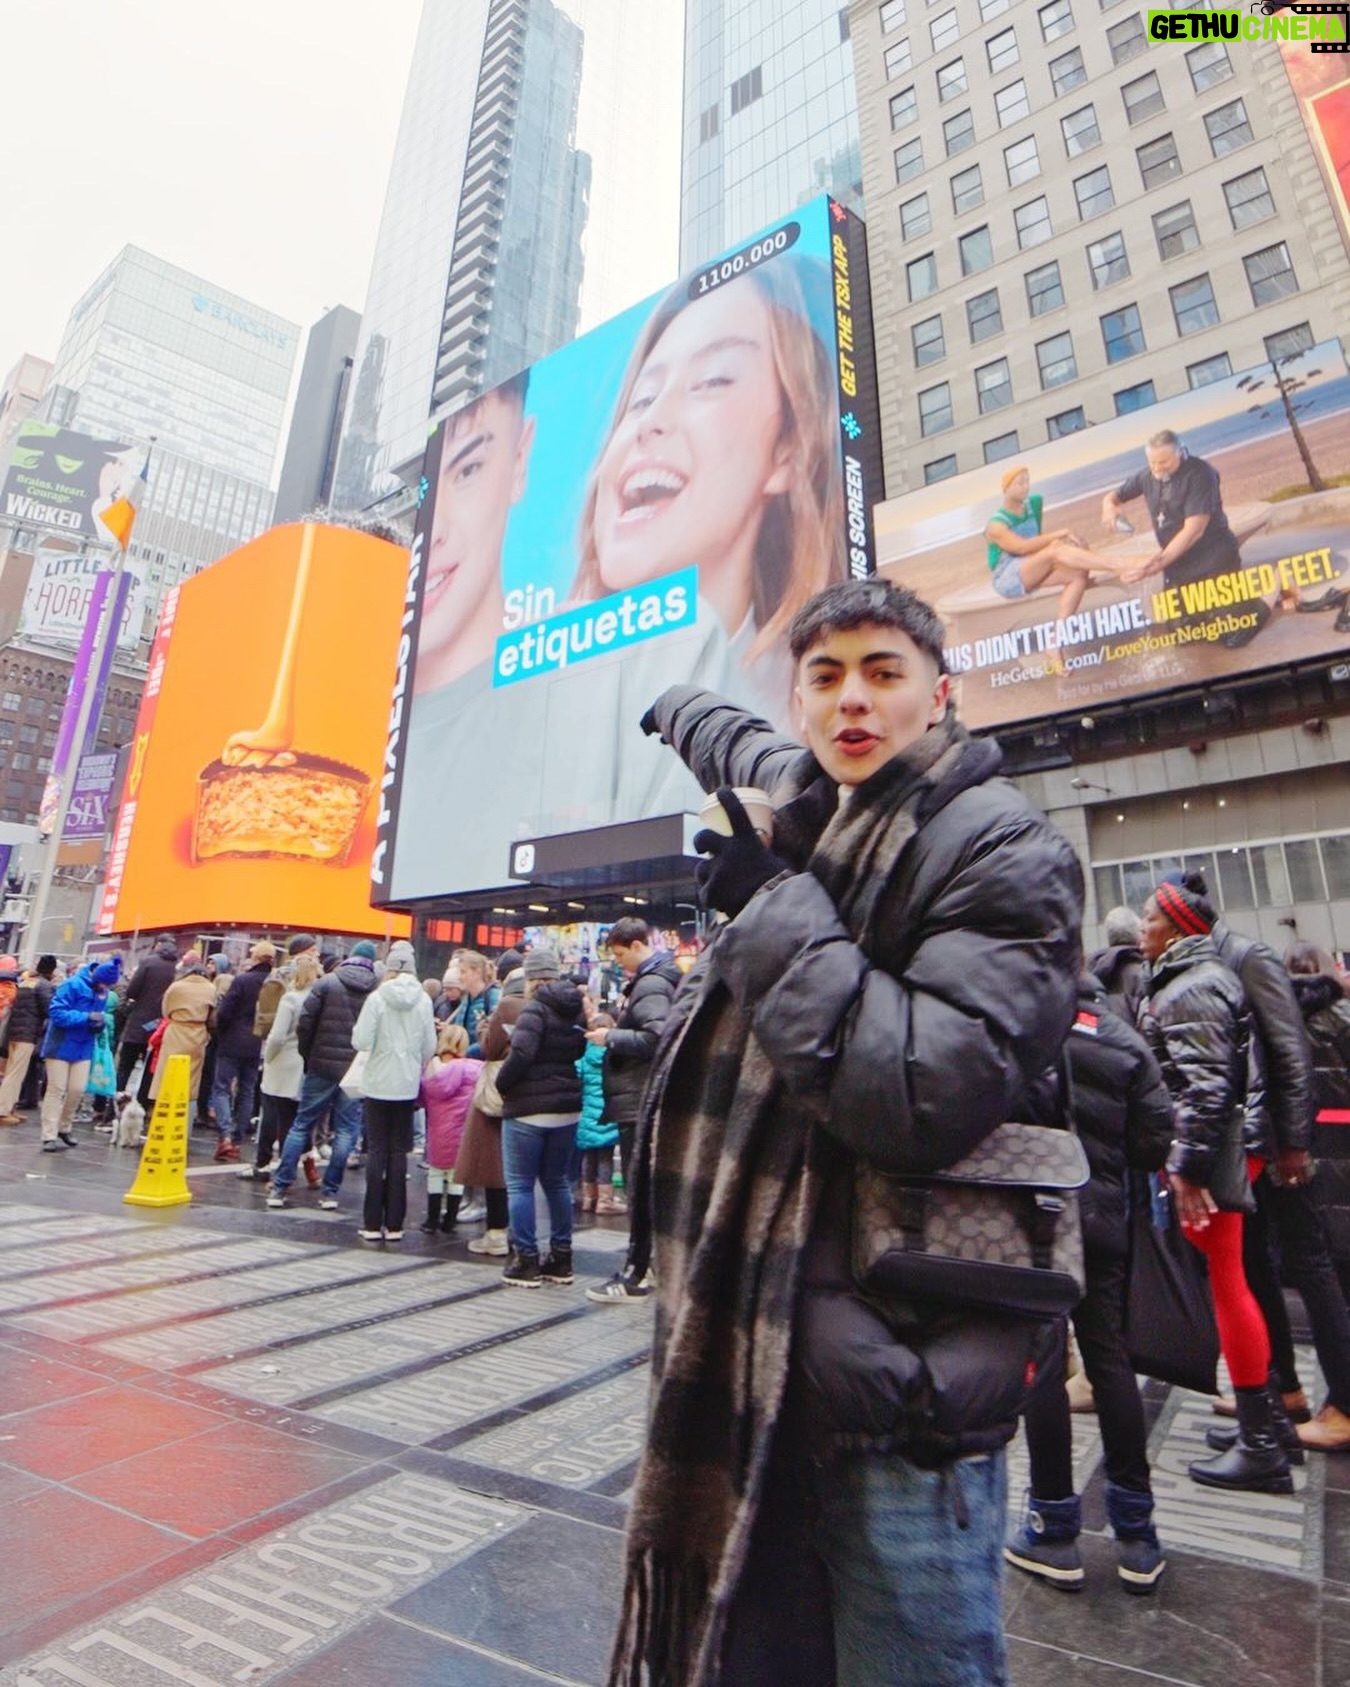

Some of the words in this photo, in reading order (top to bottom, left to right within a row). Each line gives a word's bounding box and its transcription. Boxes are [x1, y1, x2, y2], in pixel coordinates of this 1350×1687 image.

[699, 231, 788, 293] 1100.000
[832, 234, 849, 276] APP
[834, 274, 851, 311] TSX
[837, 312, 855, 352] THE
[839, 352, 857, 397] GET
[44, 559, 102, 578] LITTLE
[499, 586, 688, 668] etiquetas
[503, 583, 556, 630] Sin
[974, 627, 1033, 668] DIDN'T
[1032, 612, 1093, 652] TEACH
[1094, 598, 1151, 638] HATE.
[1152, 588, 1183, 624] HE
[1181, 563, 1277, 614] WASHED
[1277, 547, 1341, 591] FEET.
